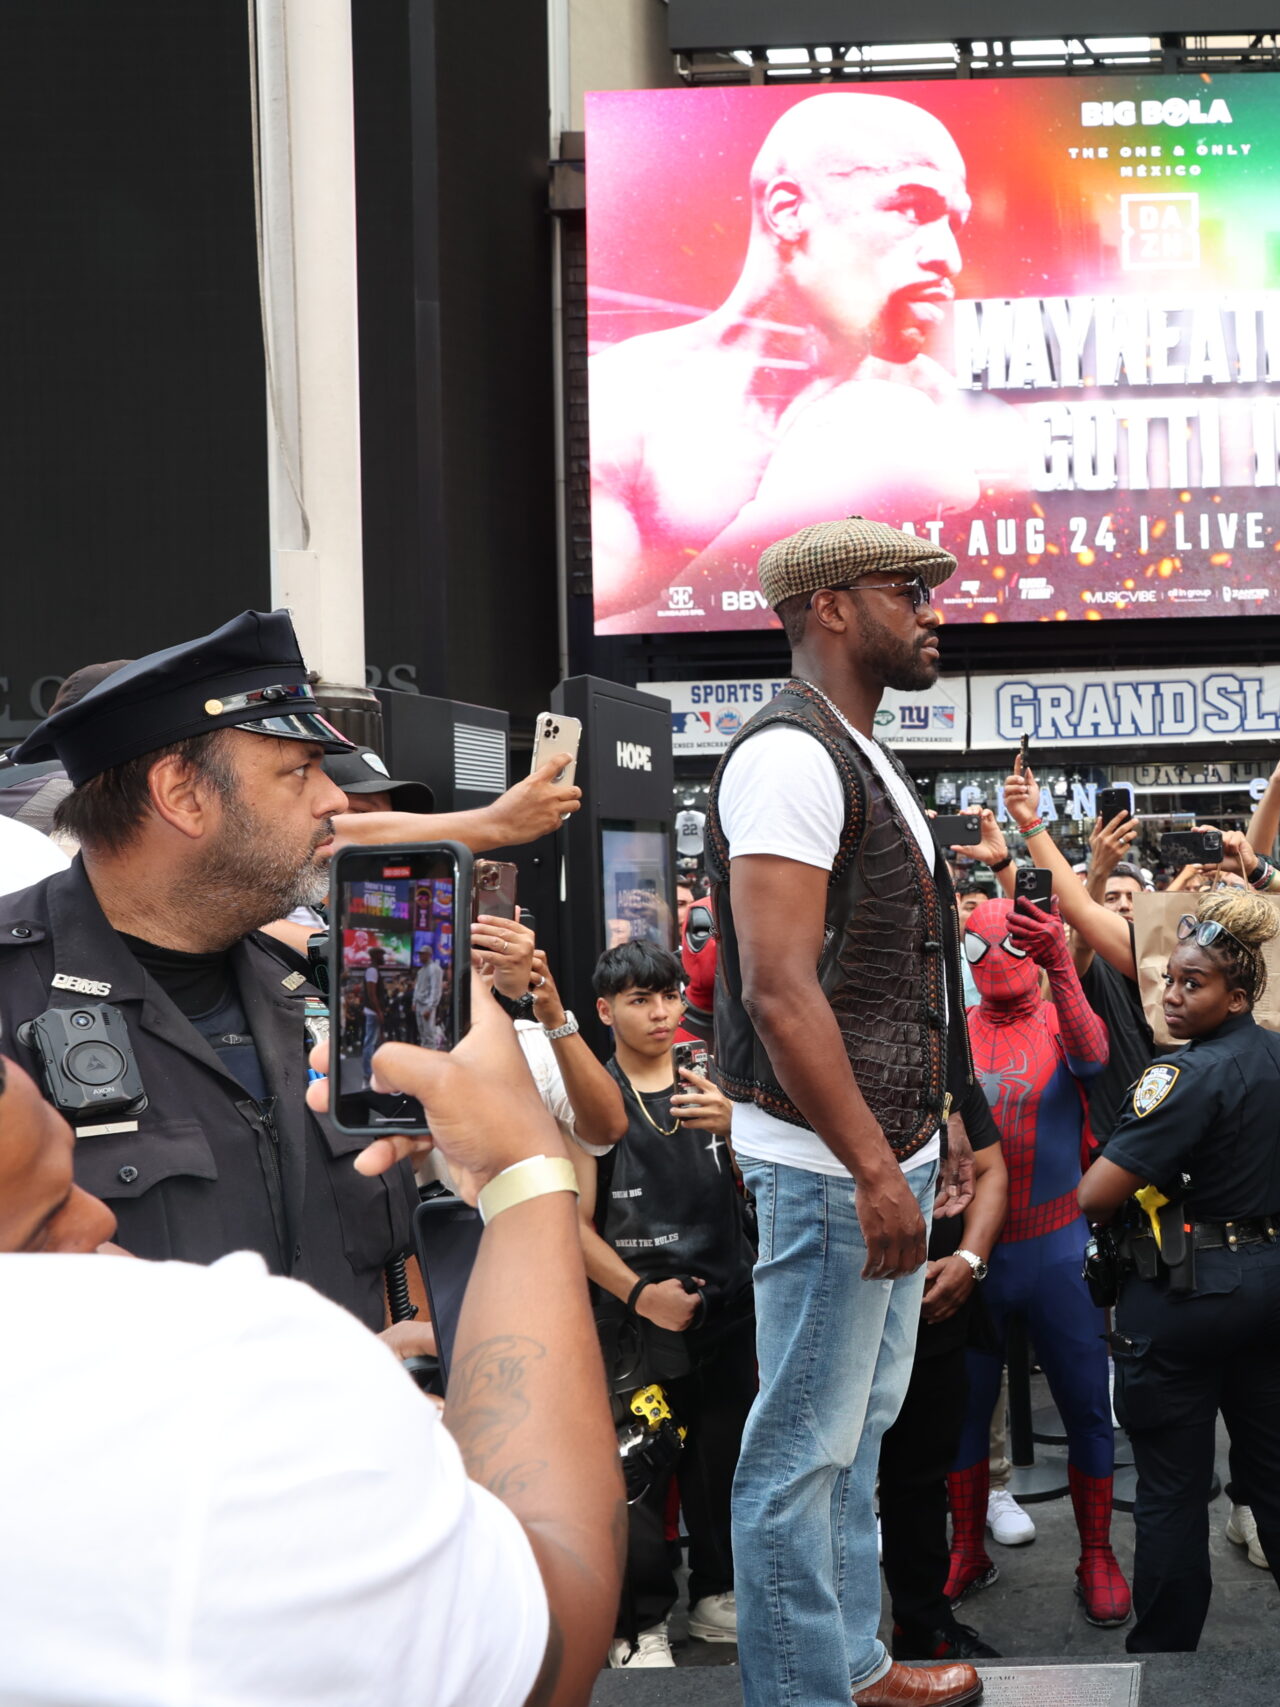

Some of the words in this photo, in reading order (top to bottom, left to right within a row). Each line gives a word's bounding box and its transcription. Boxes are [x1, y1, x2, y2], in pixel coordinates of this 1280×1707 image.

[1081, 101, 1136, 126] BIG
[1141, 97, 1233, 127] BOLA
[1068, 147, 1108, 158] THE
[1119, 146, 1162, 158] ONE
[1172, 145, 1185, 156] &
[1195, 143, 1251, 156] ONLY
[1031, 397, 1221, 492] GOTTI
[968, 517, 1046, 556] AUG
[1069, 516, 1117, 554] 24
[1175, 512, 1264, 551] LIVE
[1087, 590, 1157, 603] MUSICVIBE
[691, 684, 763, 704] SPORTS
[996, 681, 1198, 741] GRAND
[616, 740, 652, 772] HOPE
[682, 823, 698, 836] 22
[93, 1086, 115, 1096] AXON
[653, 1232, 679, 1247] RULES
